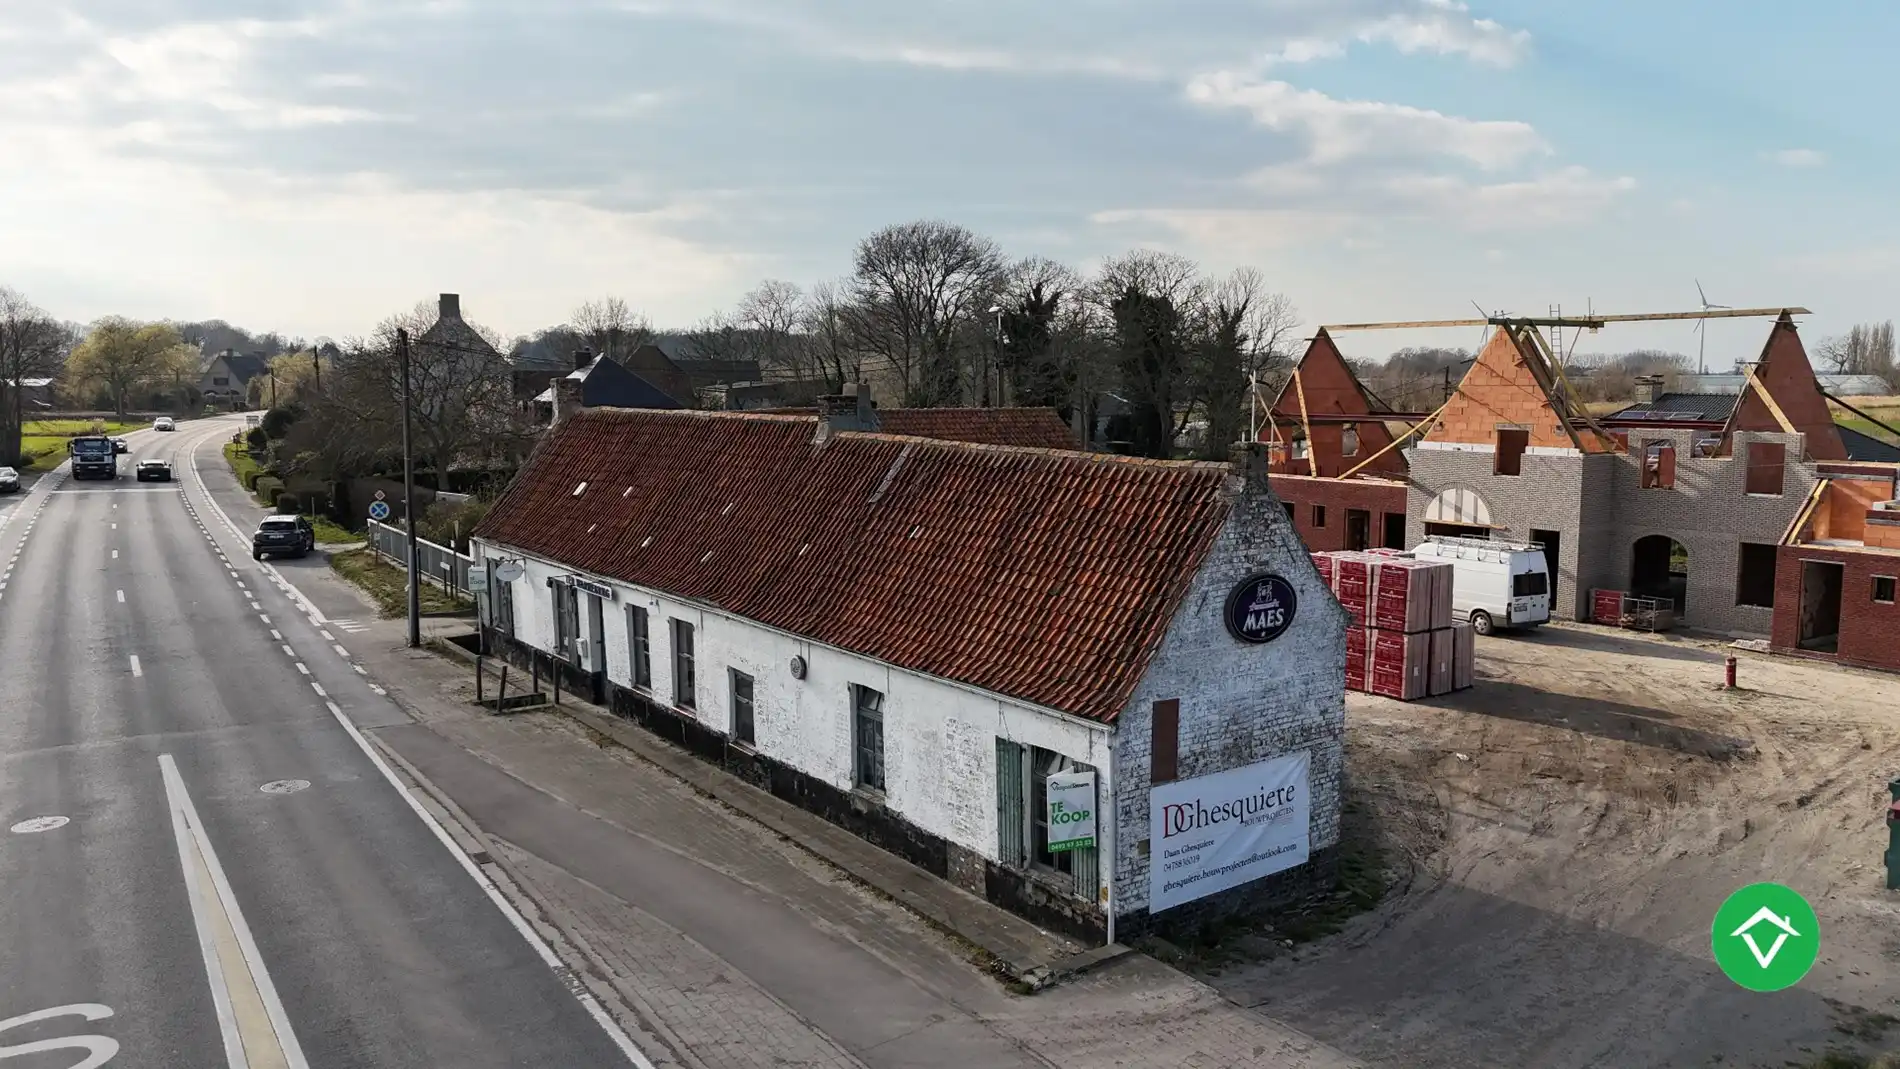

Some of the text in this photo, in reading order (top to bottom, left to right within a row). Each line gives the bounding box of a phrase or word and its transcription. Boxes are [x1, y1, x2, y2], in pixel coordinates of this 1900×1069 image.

[1242, 608, 1284, 632] MAES
[1050, 801, 1064, 814] TE
[1051, 810, 1090, 825] KOOP
[1162, 784, 1295, 839] DGhesquiere
[1164, 839, 1215, 859] Daan Ghesquiere
[1162, 843, 1298, 894] ghesquiere.bouwprojecten@outlook.com
